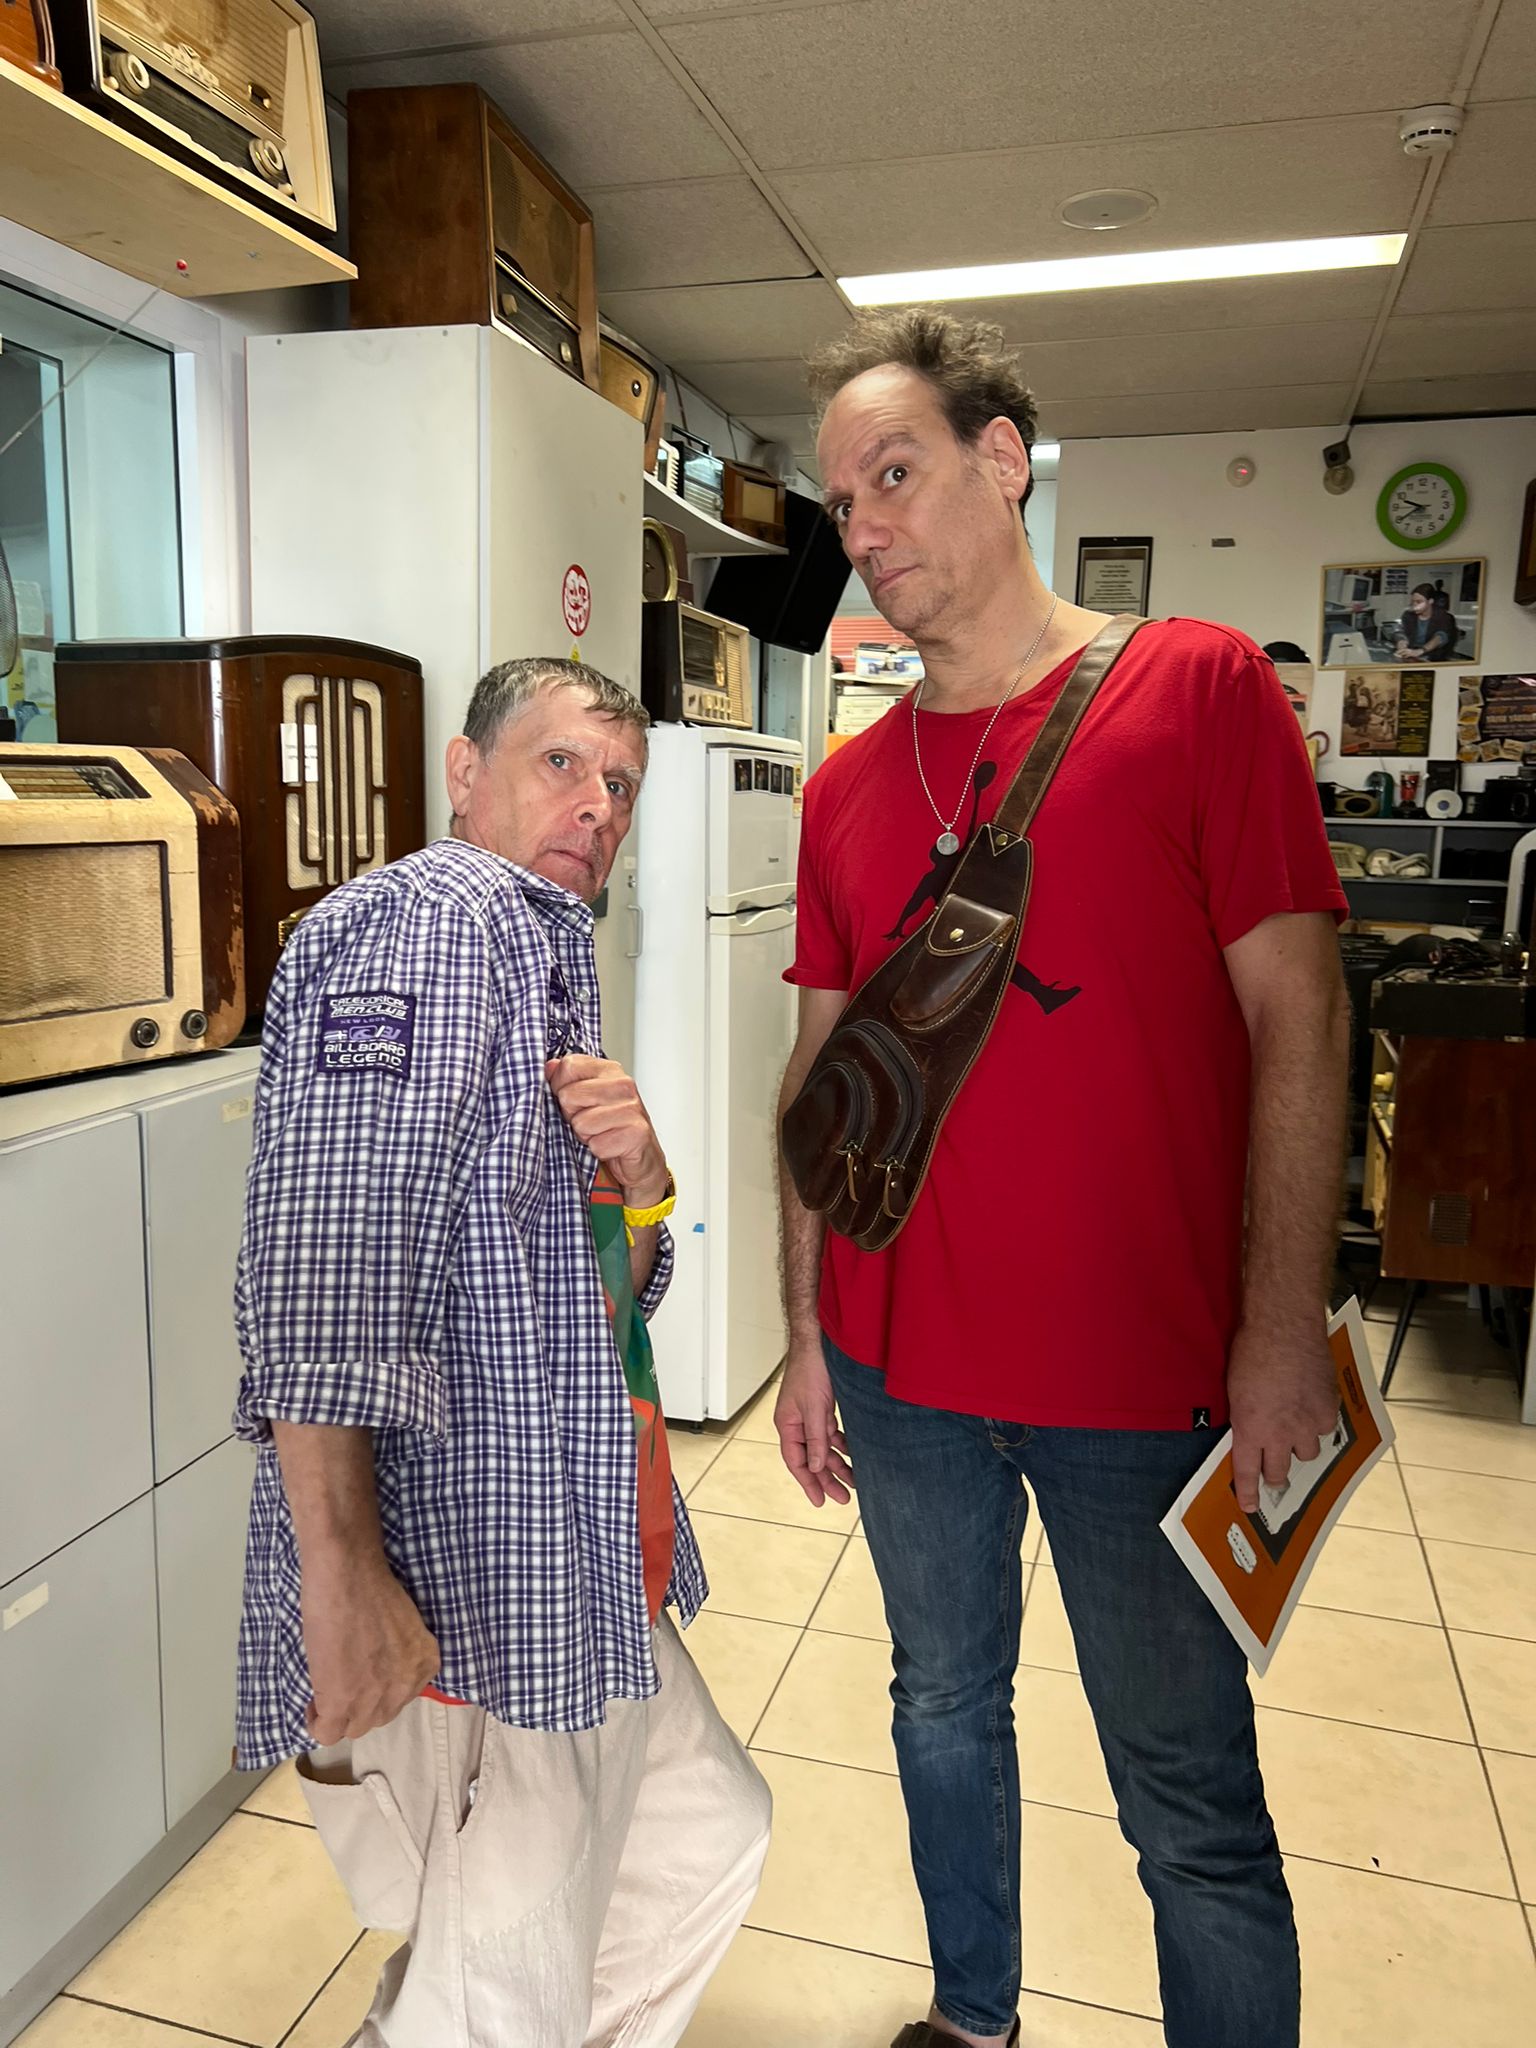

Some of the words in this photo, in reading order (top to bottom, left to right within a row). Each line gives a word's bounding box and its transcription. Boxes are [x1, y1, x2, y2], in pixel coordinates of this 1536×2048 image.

[1418, 478, 1428, 487] 12
[1397, 491, 1407, 500] 10
[1440, 490, 1449, 498] 2
[1392, 503, 1400, 512] 9
[1442, 501, 1450, 510] 3
[1438, 513, 1445, 521] 4
[1415, 526, 1423, 535] 6
[1427, 522, 1436, 531] 5
[324, 1042, 406, 1057] BILLBOARD
[326, 1052, 402, 1067] LEGEND
